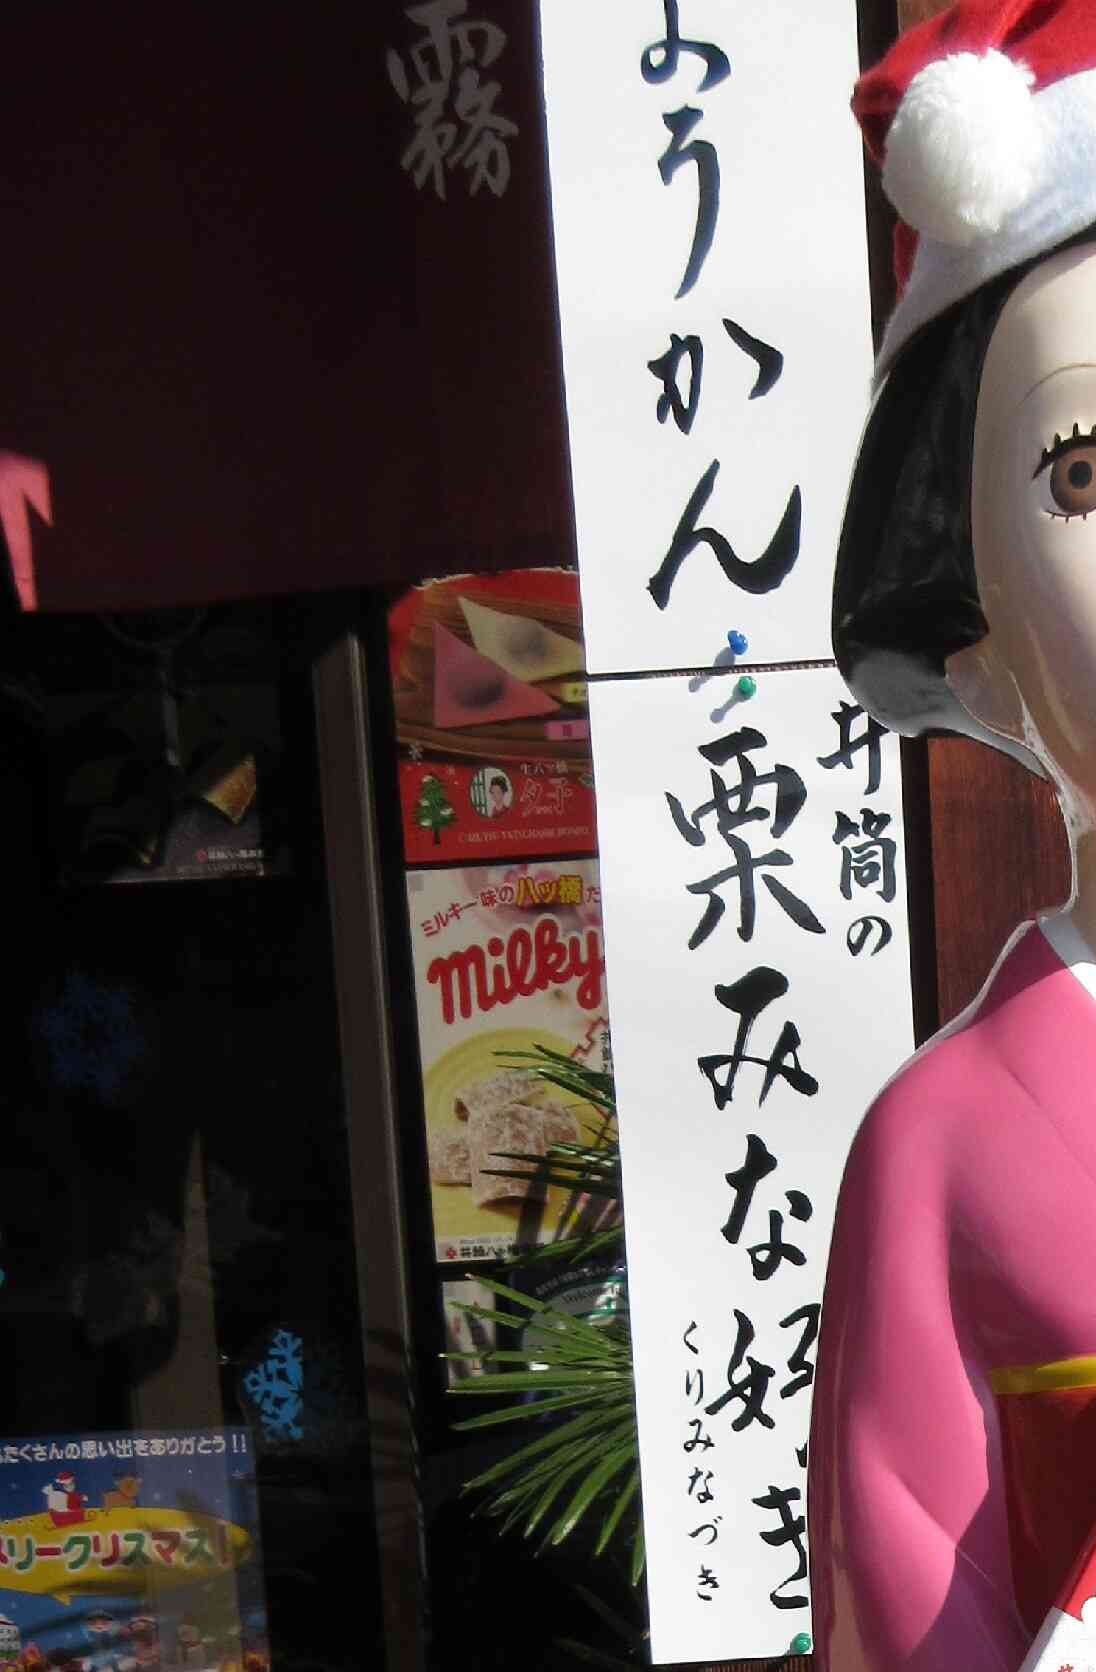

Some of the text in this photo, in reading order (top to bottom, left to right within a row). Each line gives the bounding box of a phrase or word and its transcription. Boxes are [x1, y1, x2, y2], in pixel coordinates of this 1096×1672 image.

[641, 0, 802, 609] ようかん
[816, 701, 897, 956] 井筒の
[0, 1434, 248, 1464] たくさんの思い出をありがとう!!
[683, 1321, 723, 1601] くりみなづき
